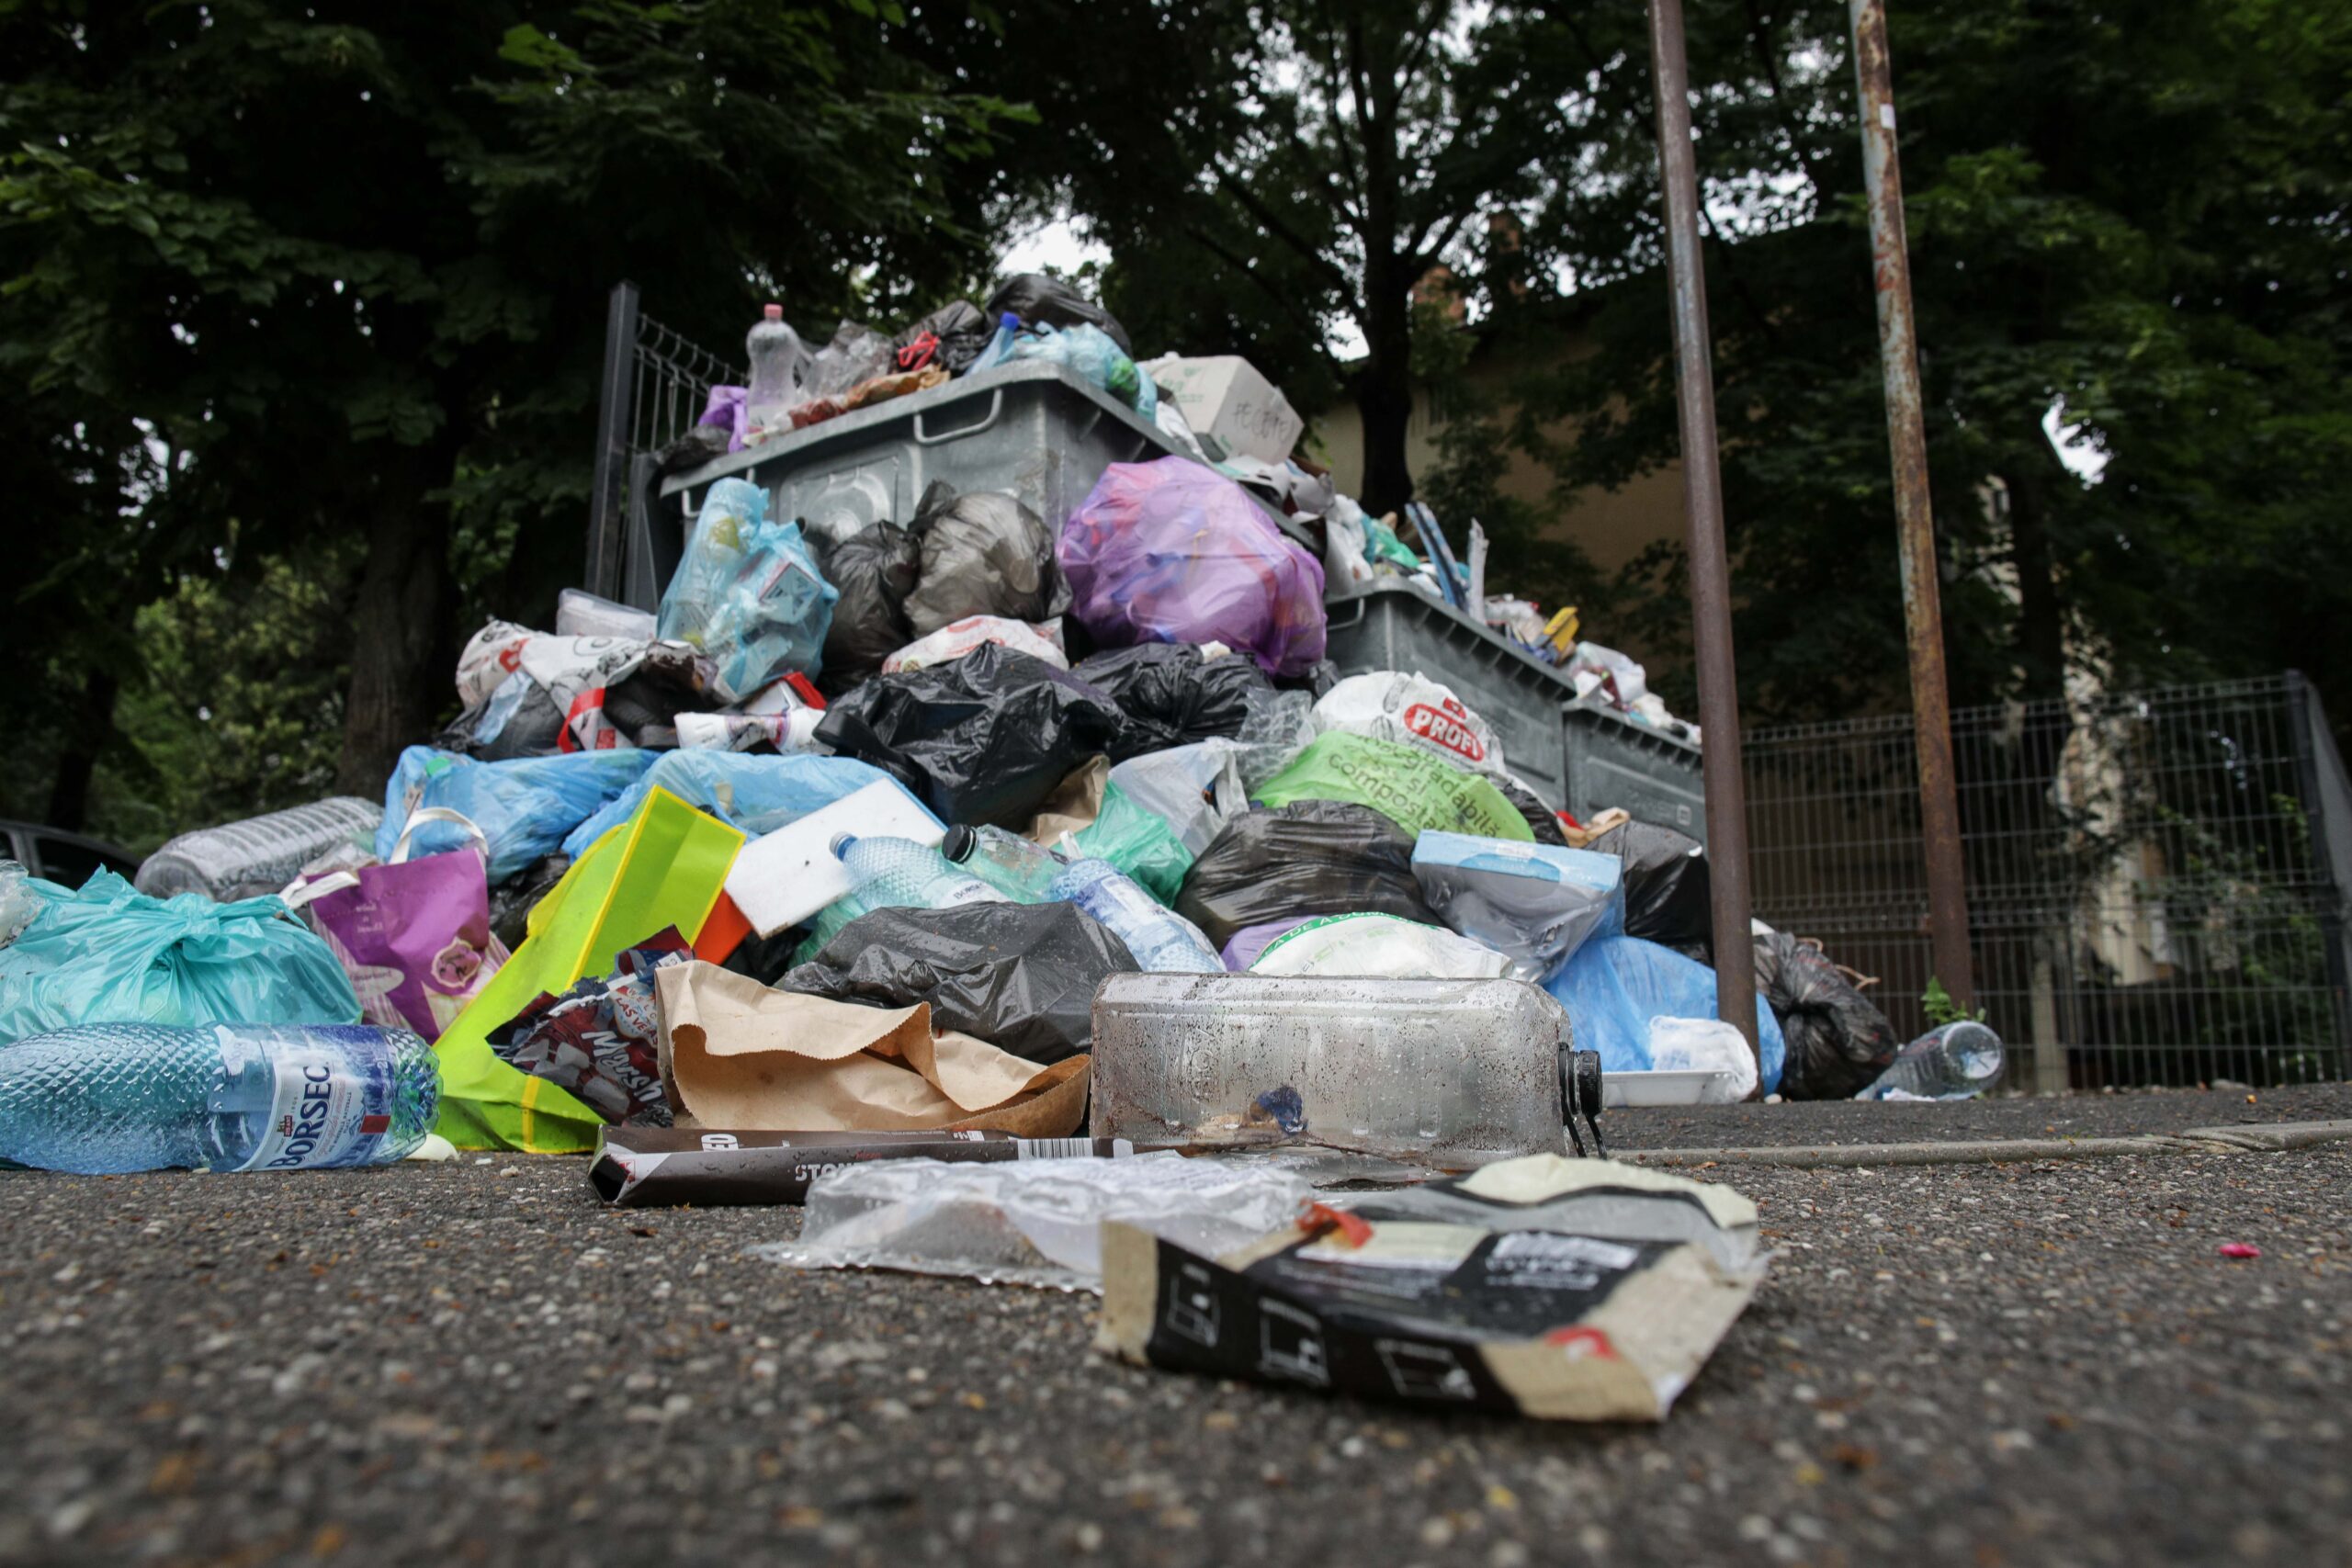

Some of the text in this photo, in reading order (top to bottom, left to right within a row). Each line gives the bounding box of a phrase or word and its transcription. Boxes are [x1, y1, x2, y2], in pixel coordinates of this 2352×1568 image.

[1411, 707, 1479, 758] PROFI
[615, 997, 637, 1020] LAS
[631, 1017, 659, 1045] VEAS
[581, 1030, 663, 1102] Marsh
[266, 1066, 331, 1166] BORSEC
